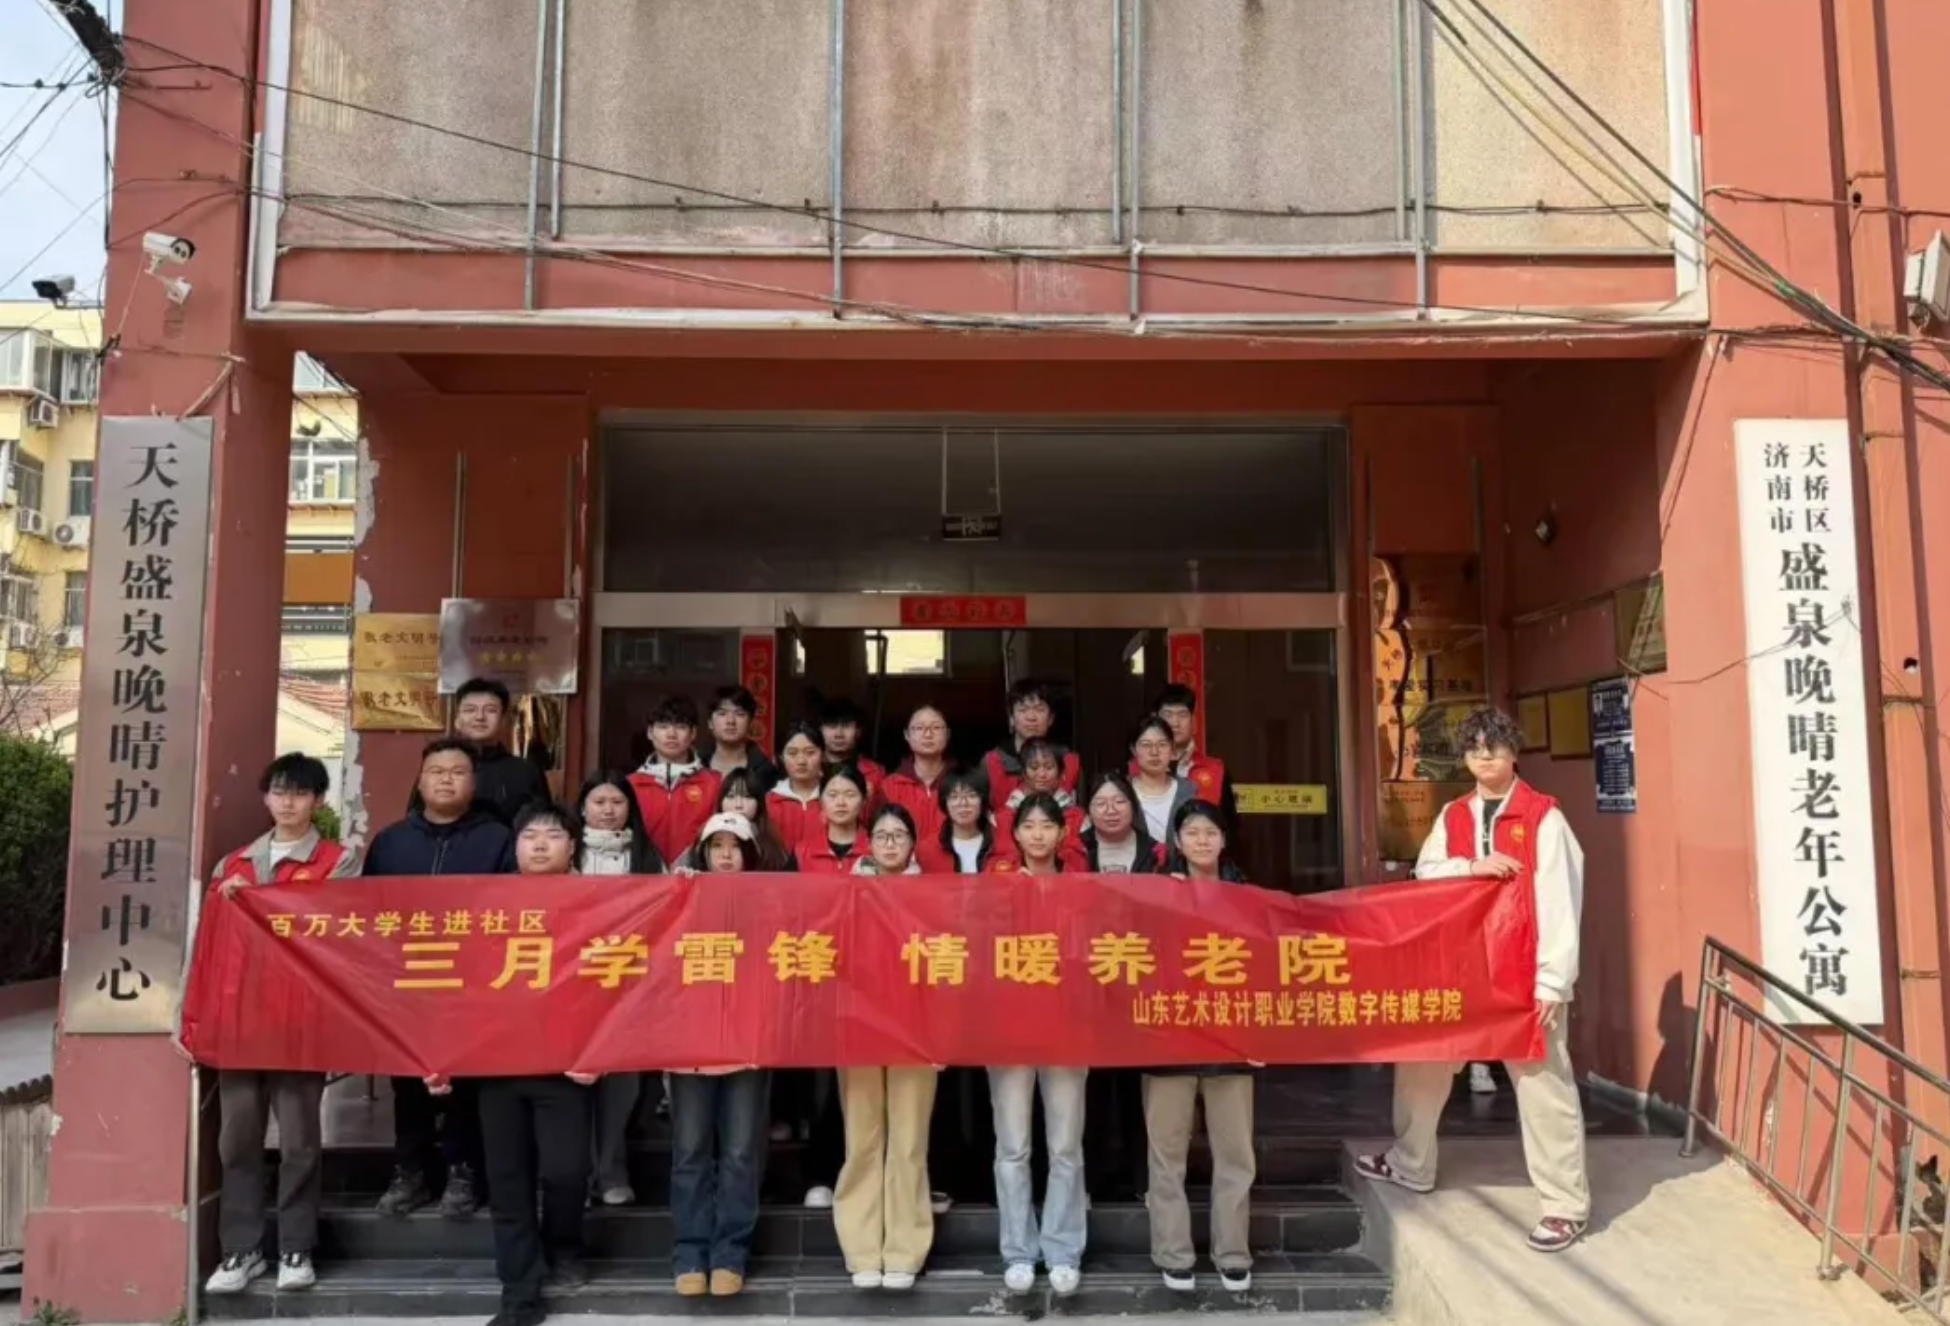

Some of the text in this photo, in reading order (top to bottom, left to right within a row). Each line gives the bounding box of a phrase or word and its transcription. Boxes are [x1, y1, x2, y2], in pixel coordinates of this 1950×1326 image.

[1764, 442, 1795, 533] 济南市
[1800, 442, 1832, 533] 天桥区
[96, 442, 180, 1001] 天桥盛泉晚晴护理中心
[1779, 542, 1849, 997] 盛泉晚晴老年公寓
[267, 910, 548, 937] 百万大学生进社区
[393, 930, 1352, 989] 三月学雷锋 情暖养老院
[1132, 989, 1462, 1027] 山东艺术设计职业学院数字传媒学院
